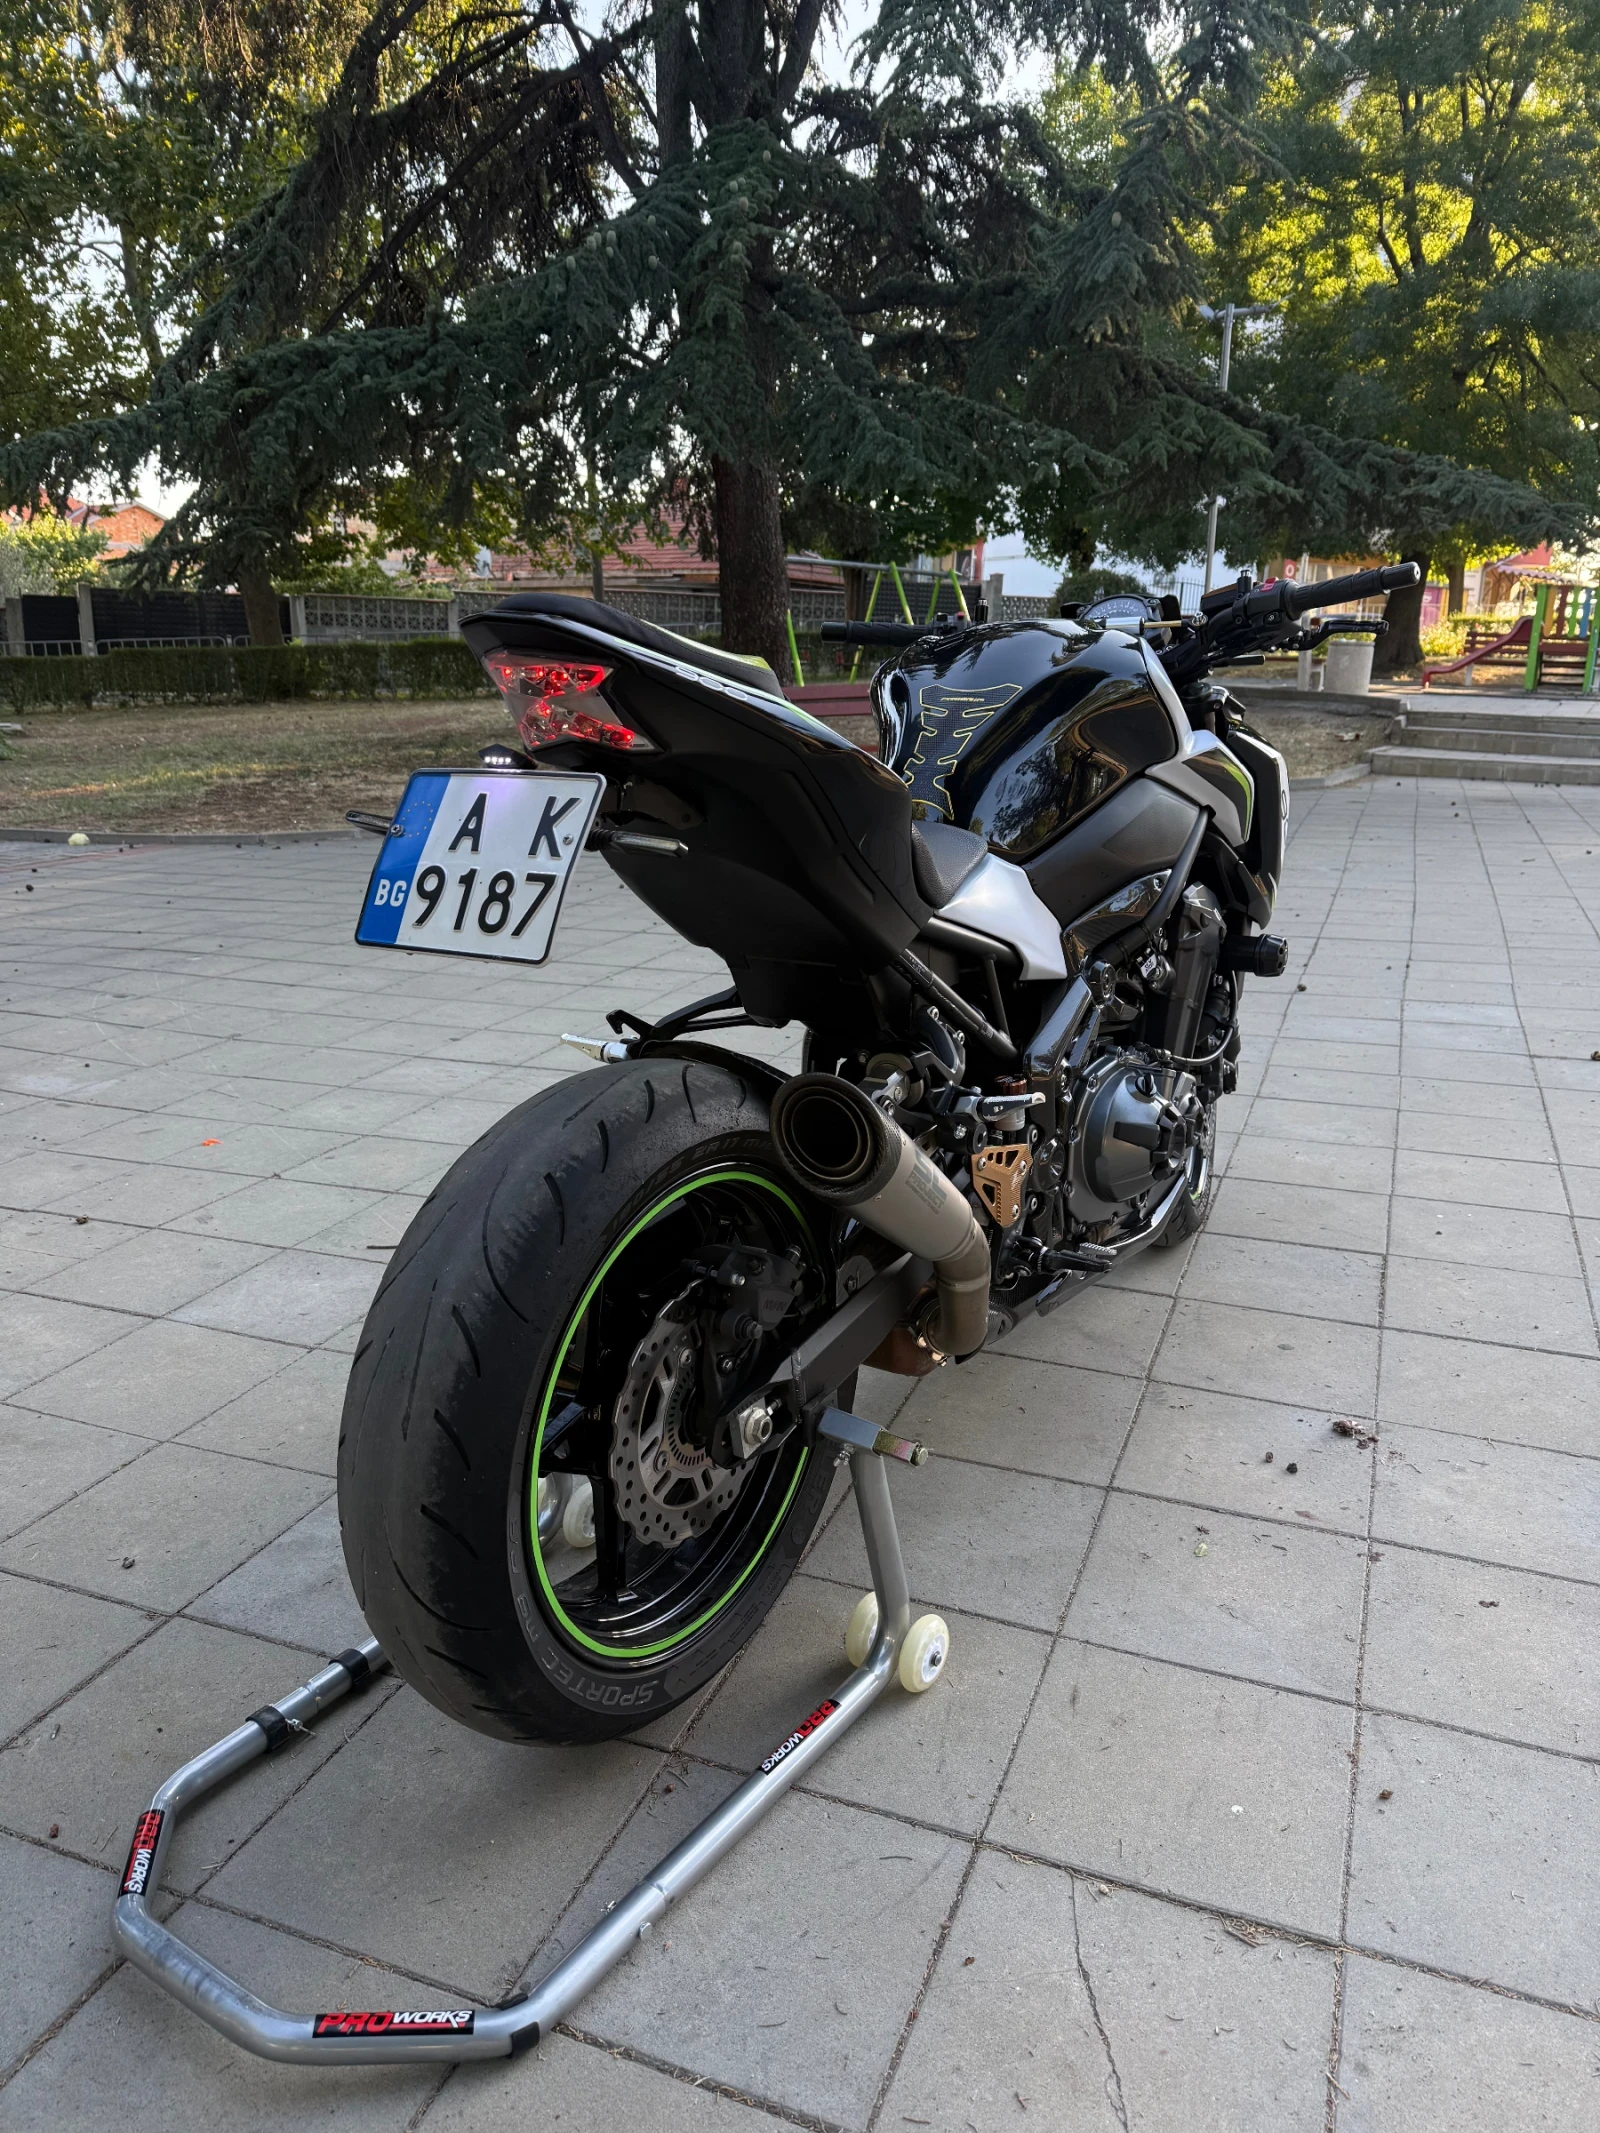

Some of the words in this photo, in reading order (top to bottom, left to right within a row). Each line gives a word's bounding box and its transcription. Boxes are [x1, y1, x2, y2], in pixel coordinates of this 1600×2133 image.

[448, 793, 487, 853] A
[528, 795, 583, 858] K
[374, 878, 408, 907] BG
[412, 864, 558, 938] 9187
[541, 1646, 660, 1707] SPORTEC
